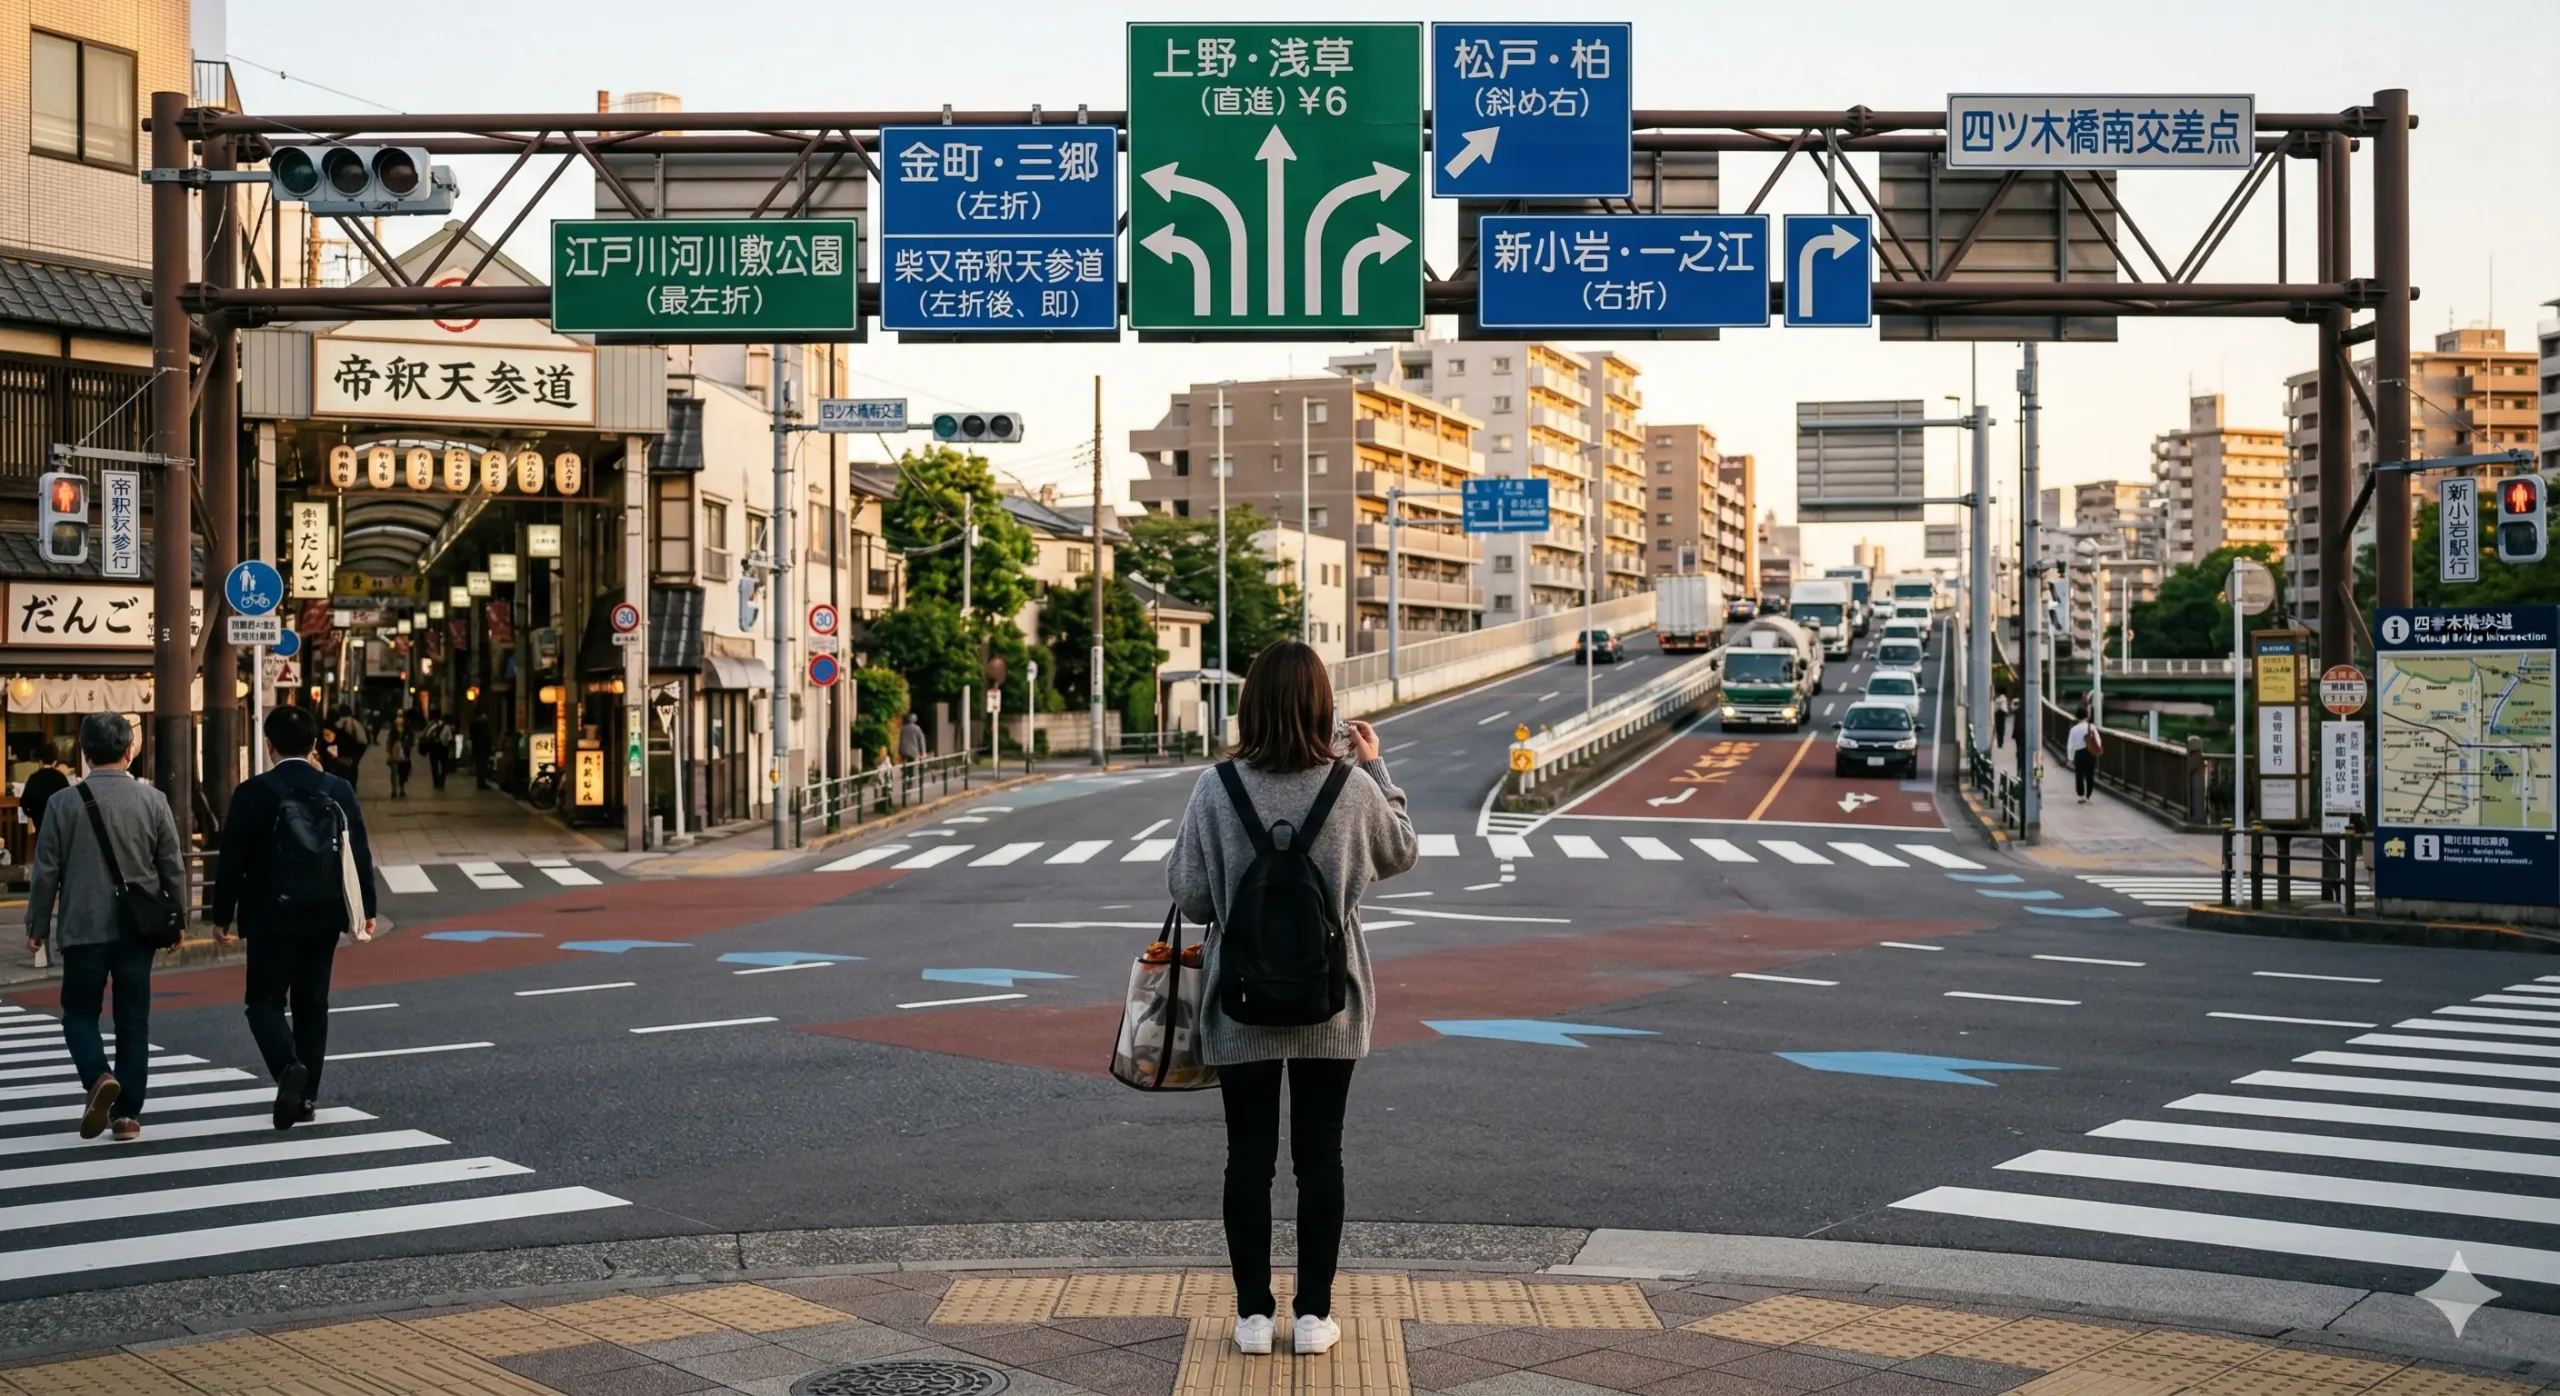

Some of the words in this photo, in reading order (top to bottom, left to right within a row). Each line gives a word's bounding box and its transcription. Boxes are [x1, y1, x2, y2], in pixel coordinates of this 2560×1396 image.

[1153, 37, 1354, 78] 上野・浅草
[1453, 38, 1610, 80] 松戸・柏
[1201, 86, 1286, 117] (直進)
[1297, 86, 1347, 116] ¥6
[1475, 86, 1589, 118] (斜め右)
[1962, 109, 2240, 155] 四ツ木橋南交差点
[899, 141, 1099, 183] 金町・三郷
[956, 190, 1041, 221] (左折)
[565, 234, 843, 278] 江戸川河川敷公園
[895, 247, 1104, 284] 柴又帝釈天参道
[1494, 229, 1755, 274] 新小岩・一之江
[647, 285, 763, 316] (最左折)
[919, 290, 1079, 319] (左折後、即)
[1583, 280, 1667, 311] (右折)
[334, 352, 578, 409] 帝釈天参道
[2448, 484, 2469, 575] 新小岩駅行
[20, 594, 139, 634] だんご
[618, 611, 634, 624] 30
[815, 612, 832, 627] 30
